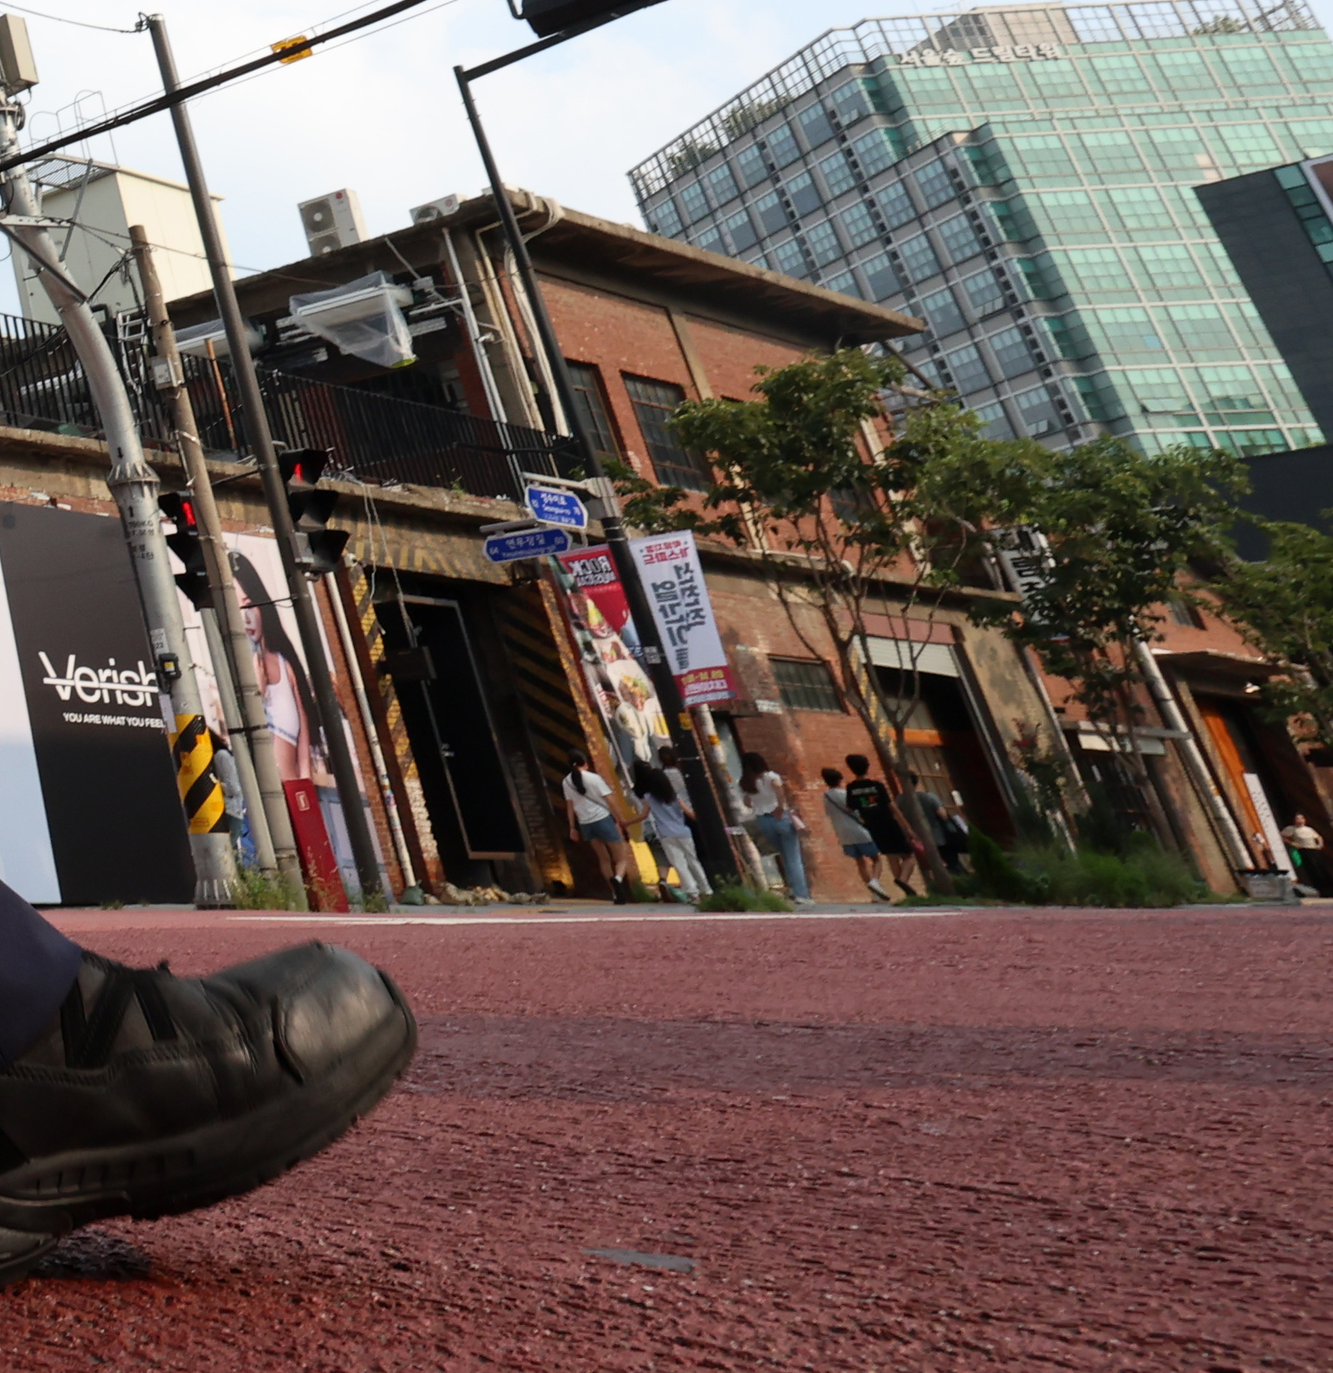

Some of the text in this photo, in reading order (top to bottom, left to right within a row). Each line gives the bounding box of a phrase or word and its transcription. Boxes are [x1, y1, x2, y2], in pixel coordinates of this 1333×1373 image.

[63, 712, 82, 723] YOU
[83, 714, 102, 724] ARE
[101, 715, 126, 726] WHAT
[126, 717, 145, 727] YOU
